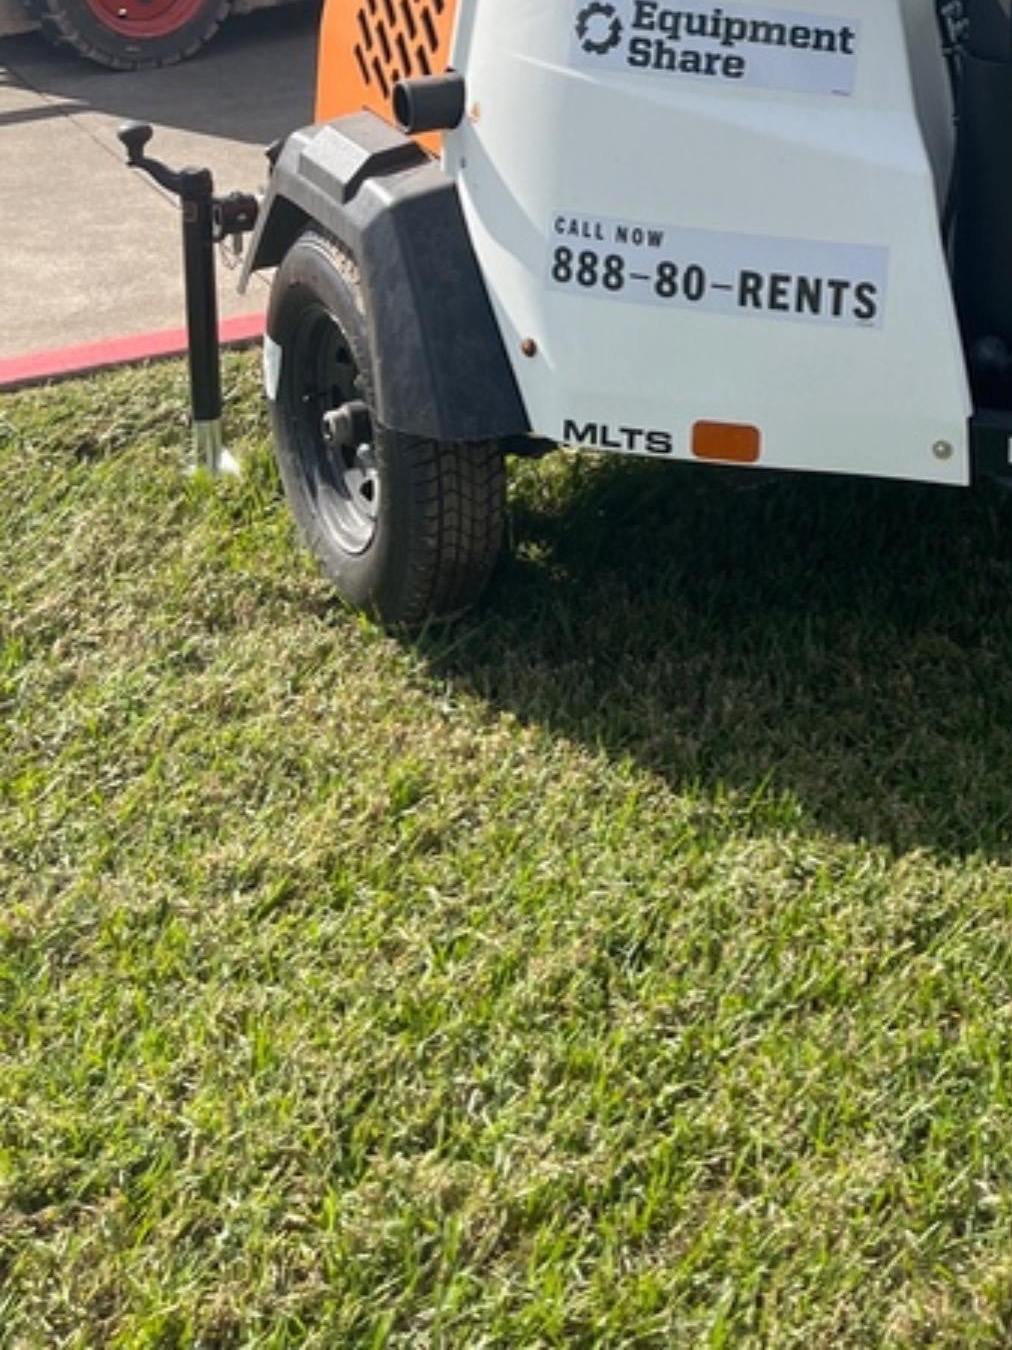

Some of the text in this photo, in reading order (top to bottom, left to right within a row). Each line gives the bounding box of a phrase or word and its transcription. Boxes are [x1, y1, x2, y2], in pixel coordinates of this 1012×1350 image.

[632, 0, 856, 54] Equipment
[626, 36, 746, 79] Share
[554, 216, 664, 247] CALL NOW
[552, 246, 877, 320] 888-80-RENTS
[563, 419, 673, 454] MLTS
